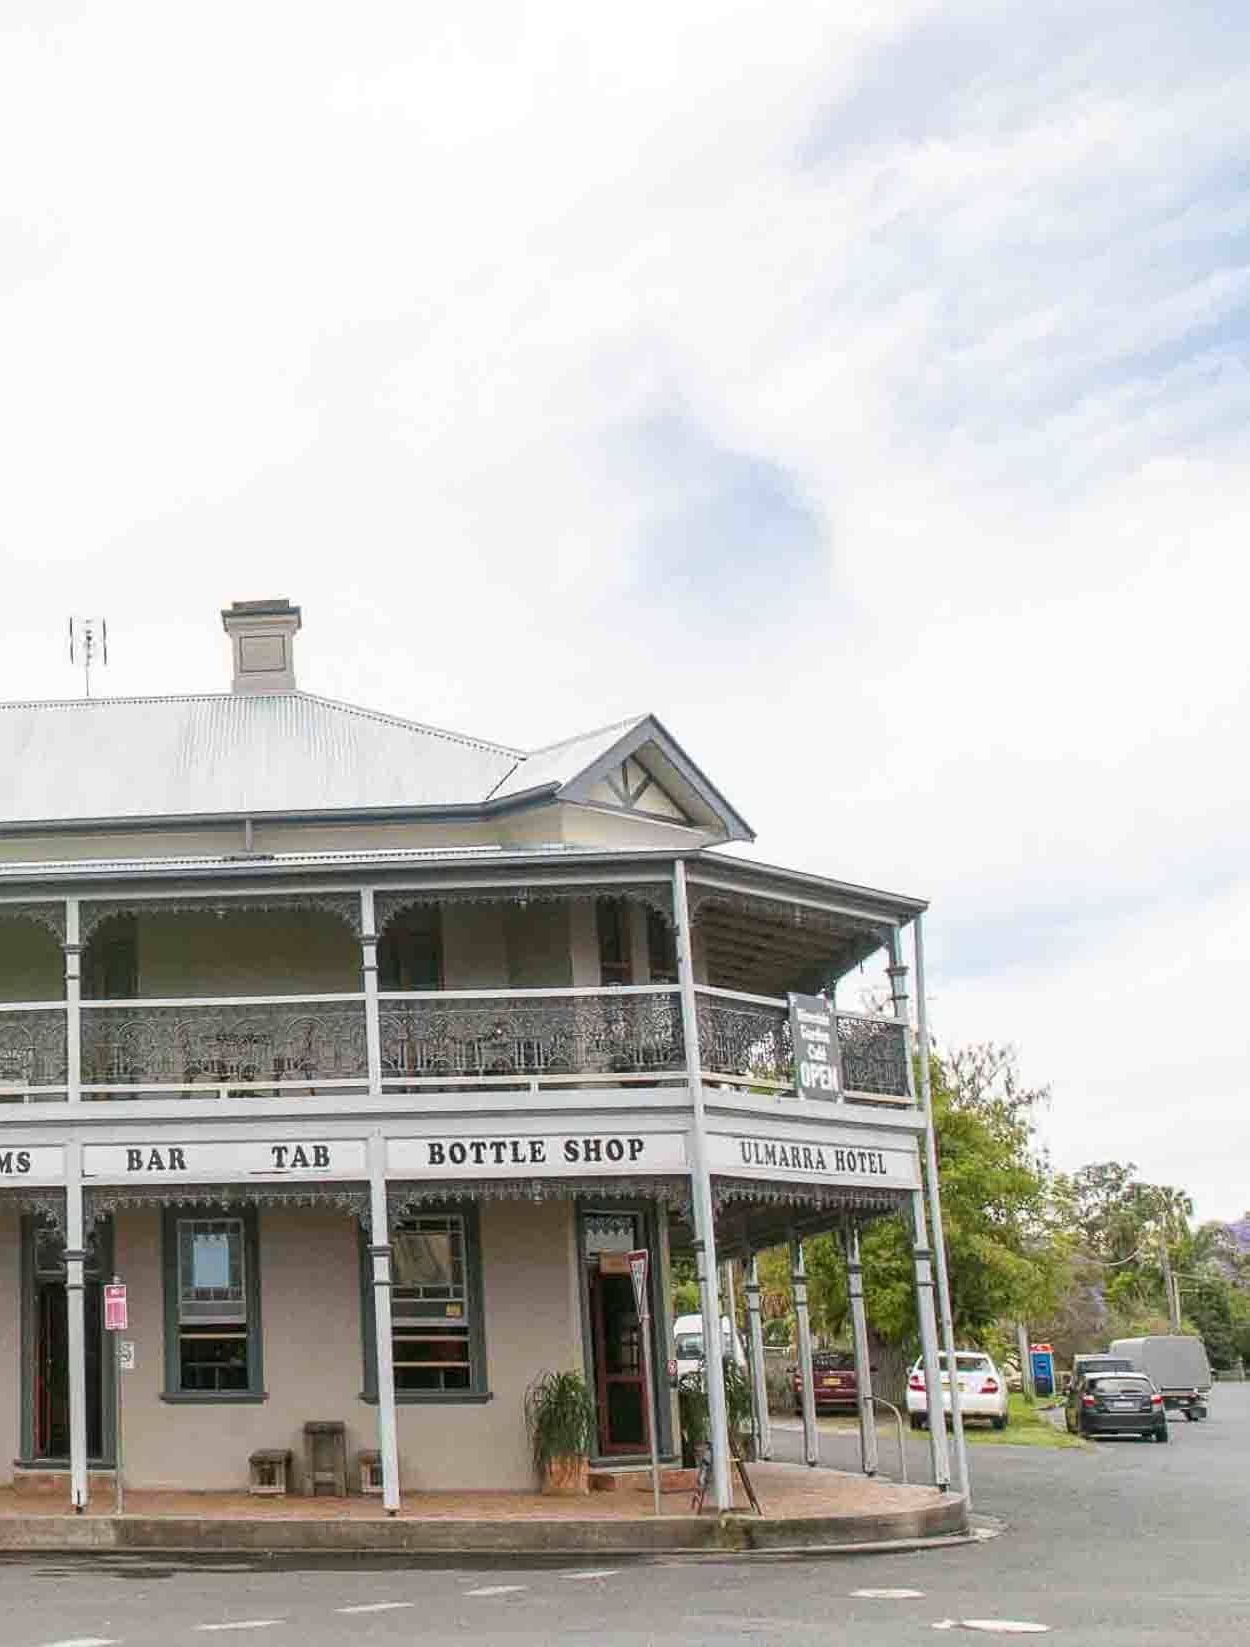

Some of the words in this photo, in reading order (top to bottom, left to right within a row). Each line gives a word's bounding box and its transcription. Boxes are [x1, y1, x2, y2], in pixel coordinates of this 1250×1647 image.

[799, 1061, 838, 1091] OPEN
[127, 1148, 186, 1171] BAR
[271, 1144, 331, 1168] TAB
[428, 1140, 546, 1165] BOTTLE
[564, 1139, 644, 1163] SHOP
[741, 1141, 827, 1170] ULMARRA
[835, 1150, 887, 1175] HOTEL
